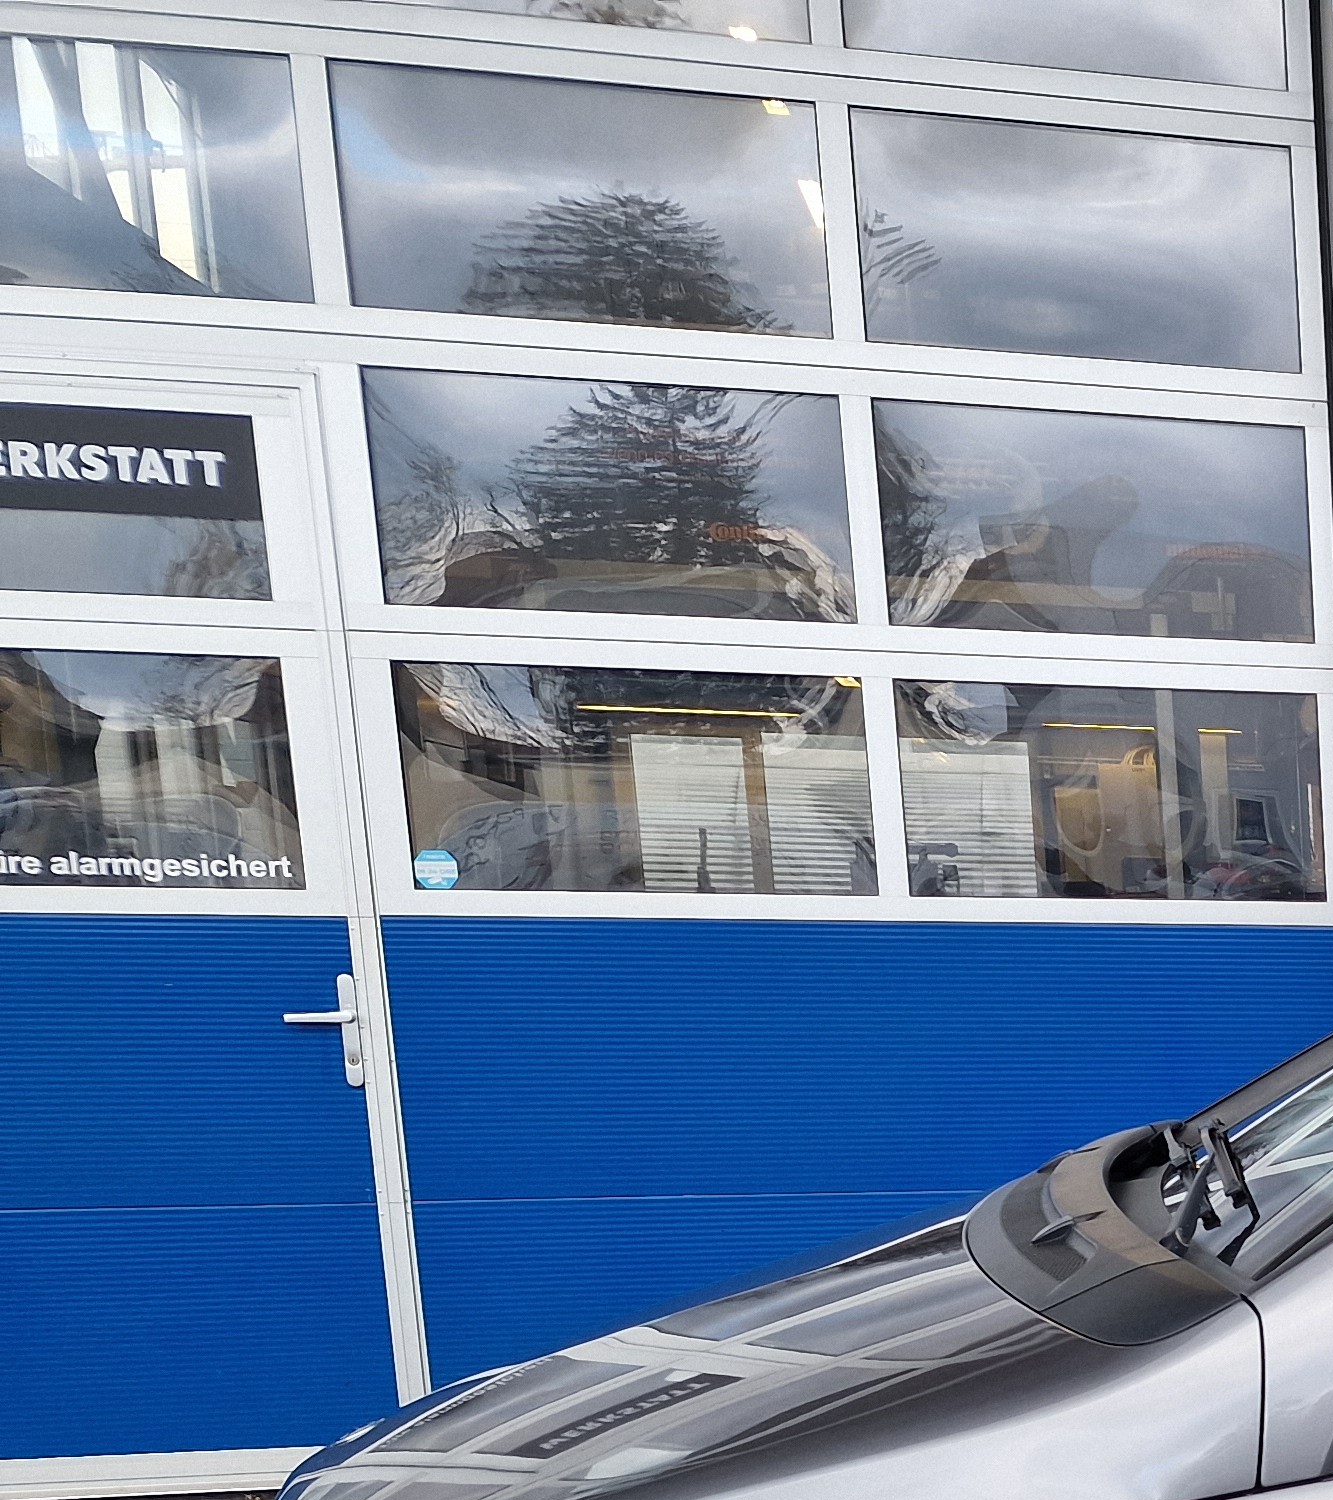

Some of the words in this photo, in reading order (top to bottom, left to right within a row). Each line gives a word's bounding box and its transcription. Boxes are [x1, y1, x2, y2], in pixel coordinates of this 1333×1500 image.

[0, 440, 226, 488] RKSTATT
[0, 853, 42, 875] re
[50, 851, 292, 882] alarmgesichert
